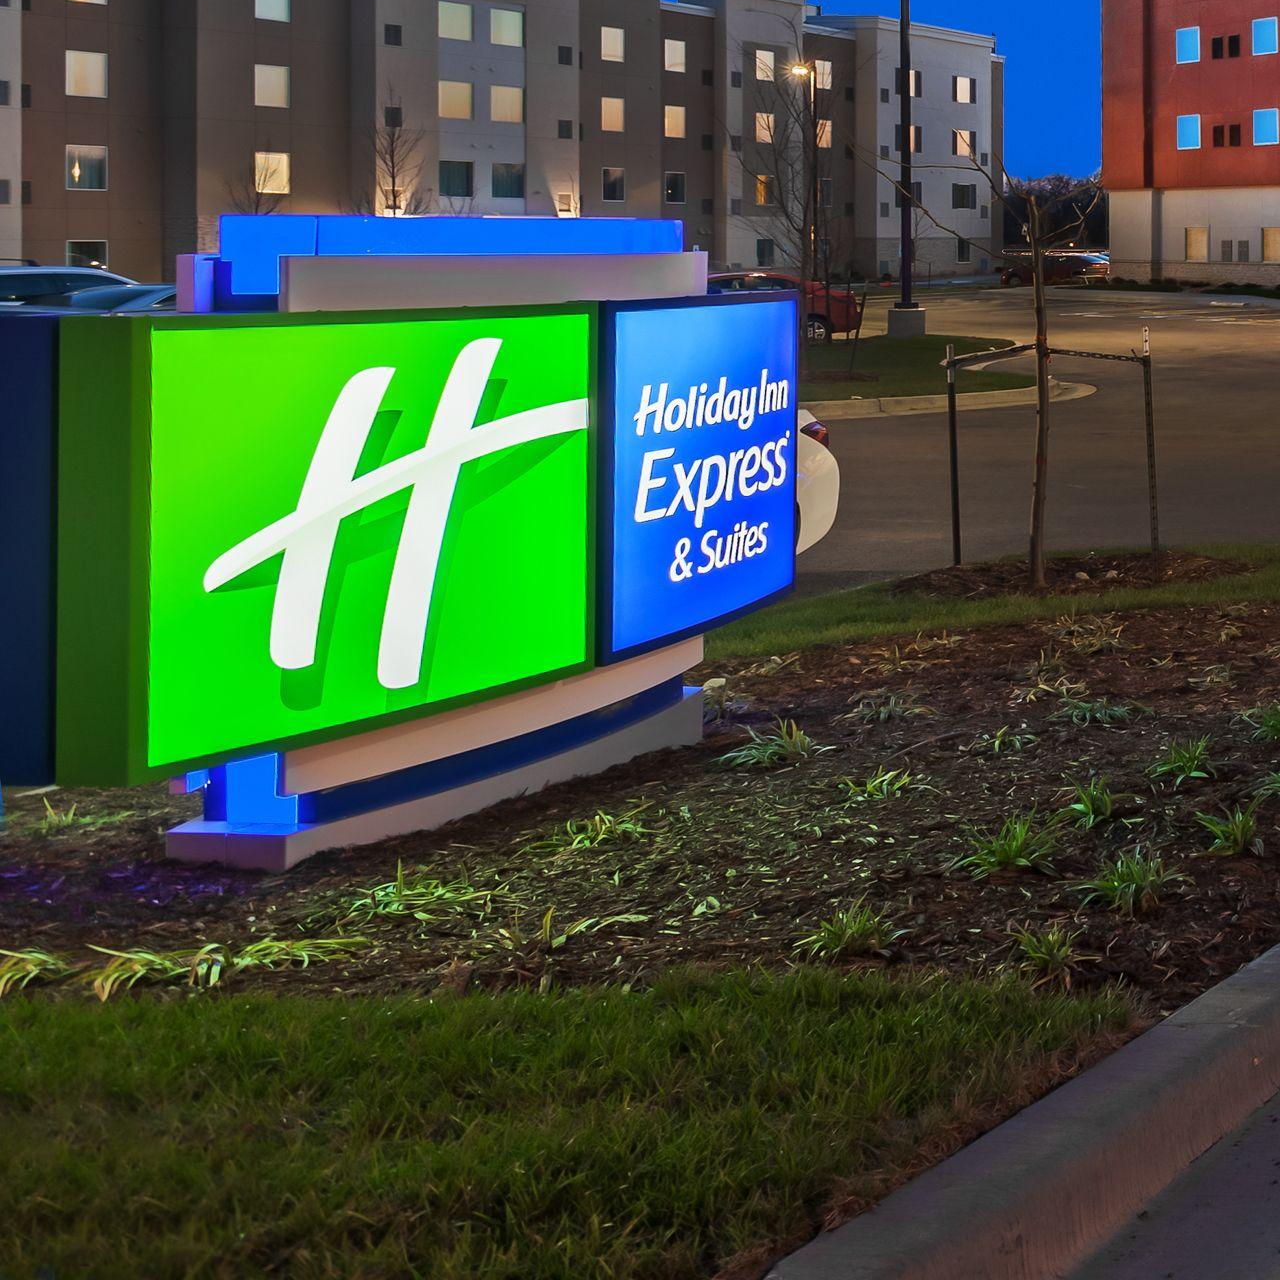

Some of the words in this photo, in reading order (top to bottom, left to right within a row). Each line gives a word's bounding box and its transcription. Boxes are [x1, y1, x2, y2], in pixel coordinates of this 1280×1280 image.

[633, 376, 757, 436] Holiday
[758, 368, 789, 415] Inn
[633, 435, 789, 529] Express
[669, 537, 694, 583] &
[697, 520, 769, 574] Suites
